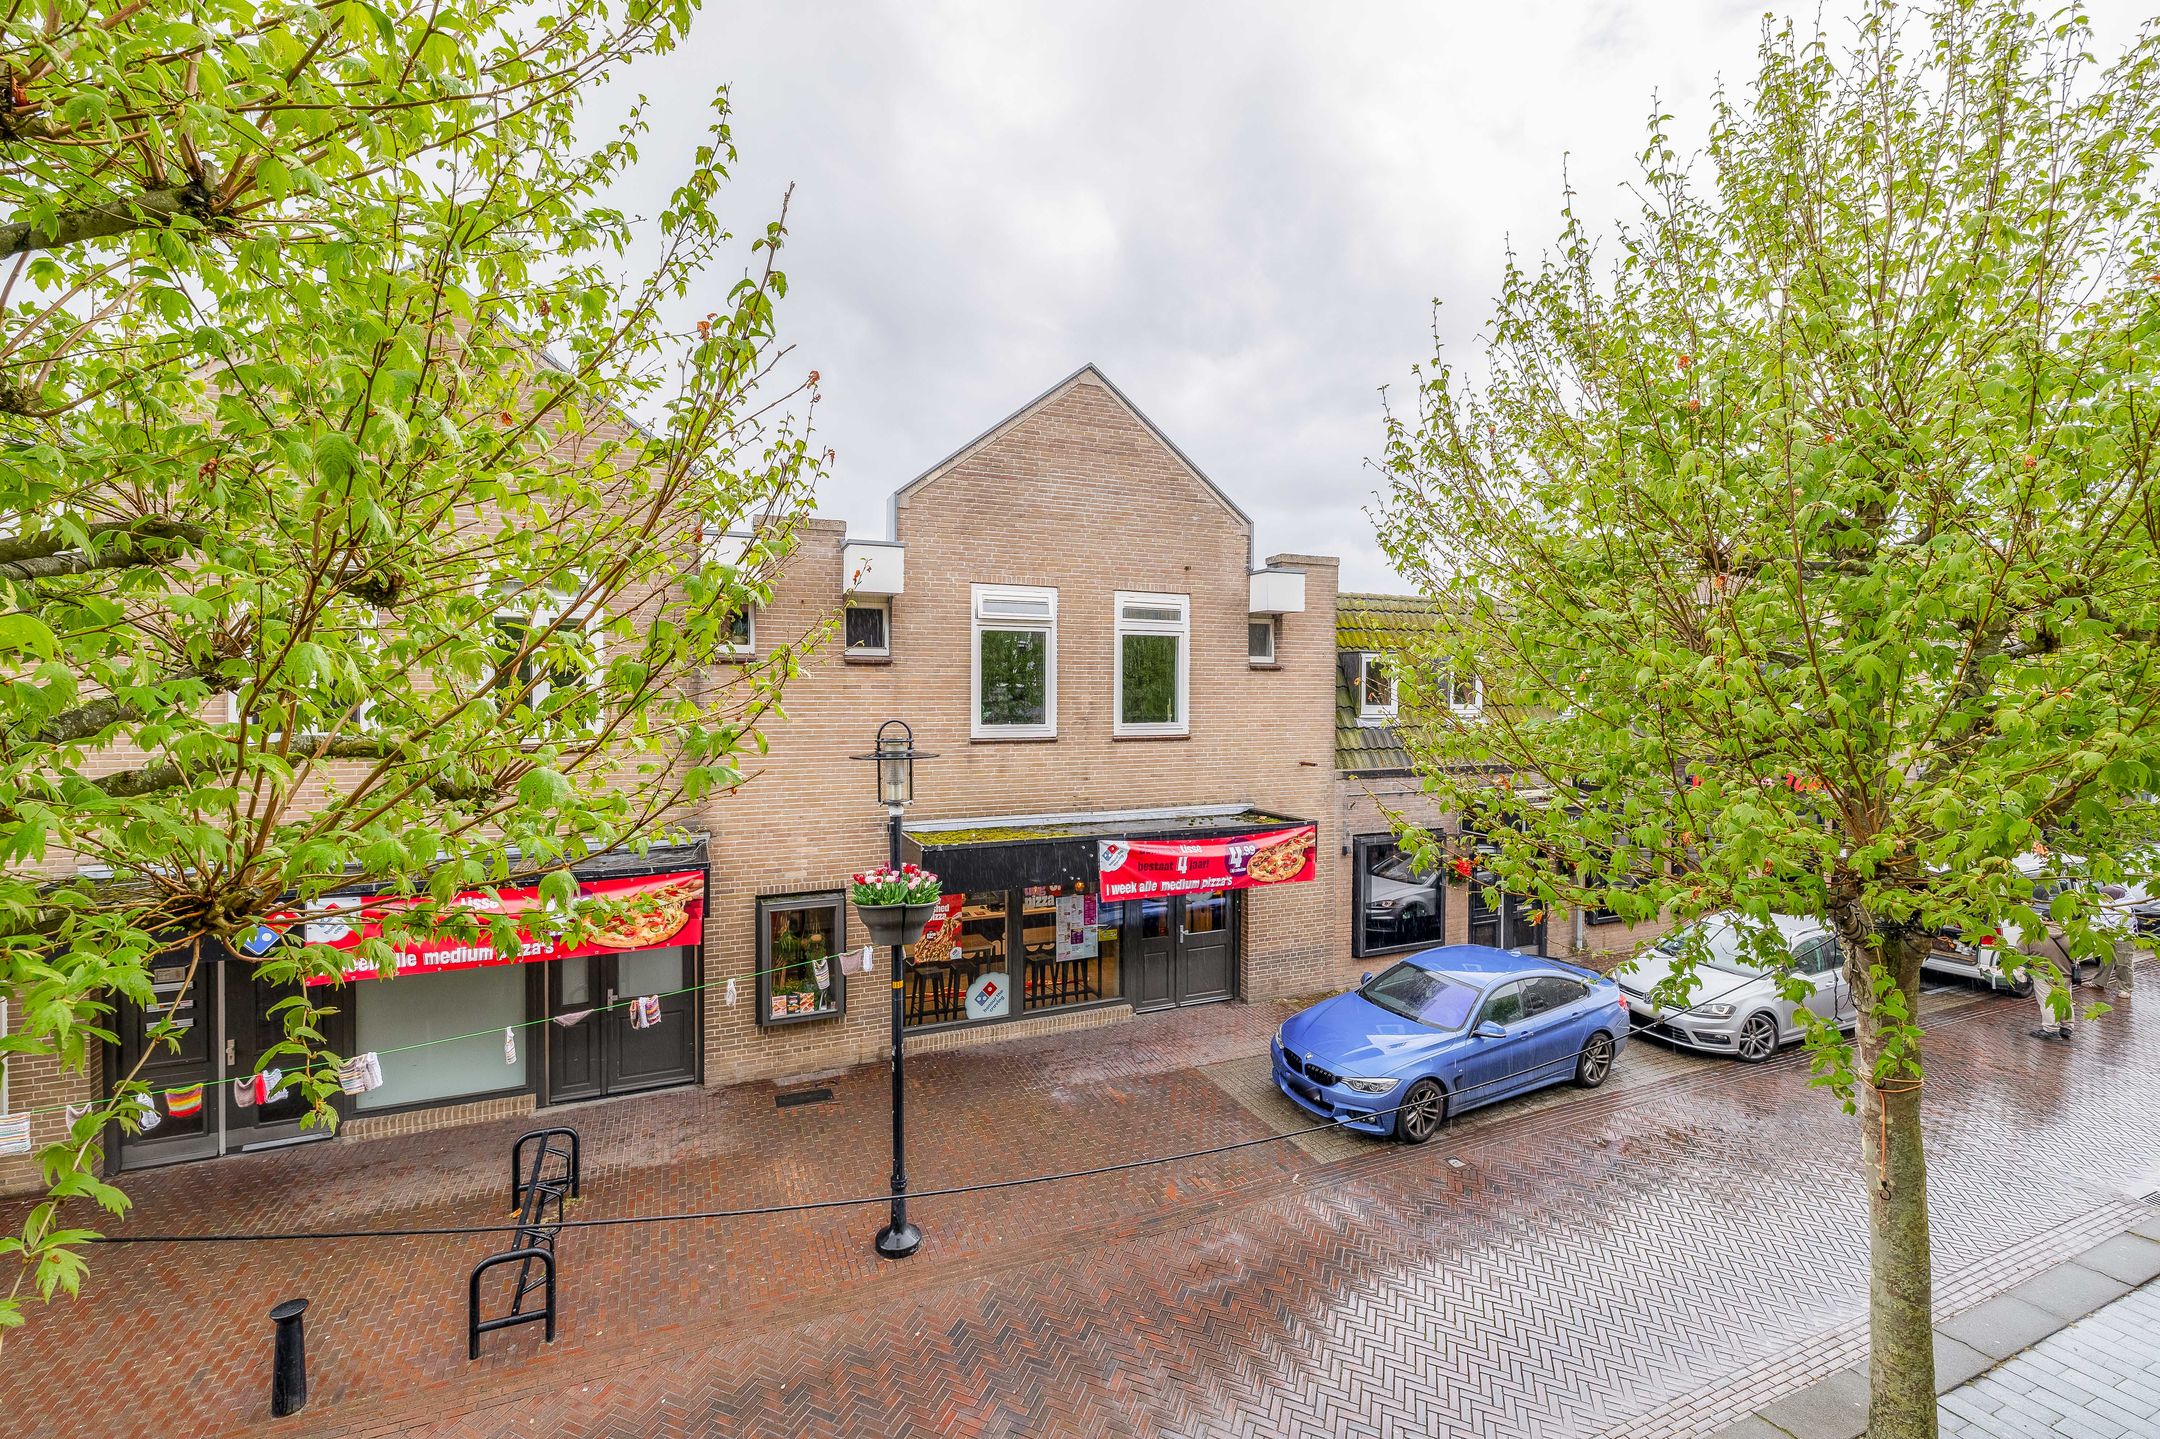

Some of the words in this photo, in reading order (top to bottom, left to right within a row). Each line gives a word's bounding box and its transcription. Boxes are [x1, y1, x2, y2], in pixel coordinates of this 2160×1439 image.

[1138, 861, 1174, 871] bestaat
[1176, 856, 1188, 874] 4
[1189, 859, 1209, 871] jaar!
[1111, 881, 1137, 895] week
[1139, 881, 1158, 892] alle
[1161, 879, 1200, 891] medium
[1201, 876, 1233, 890] pizza's
[423, 946, 494, 966] medium
